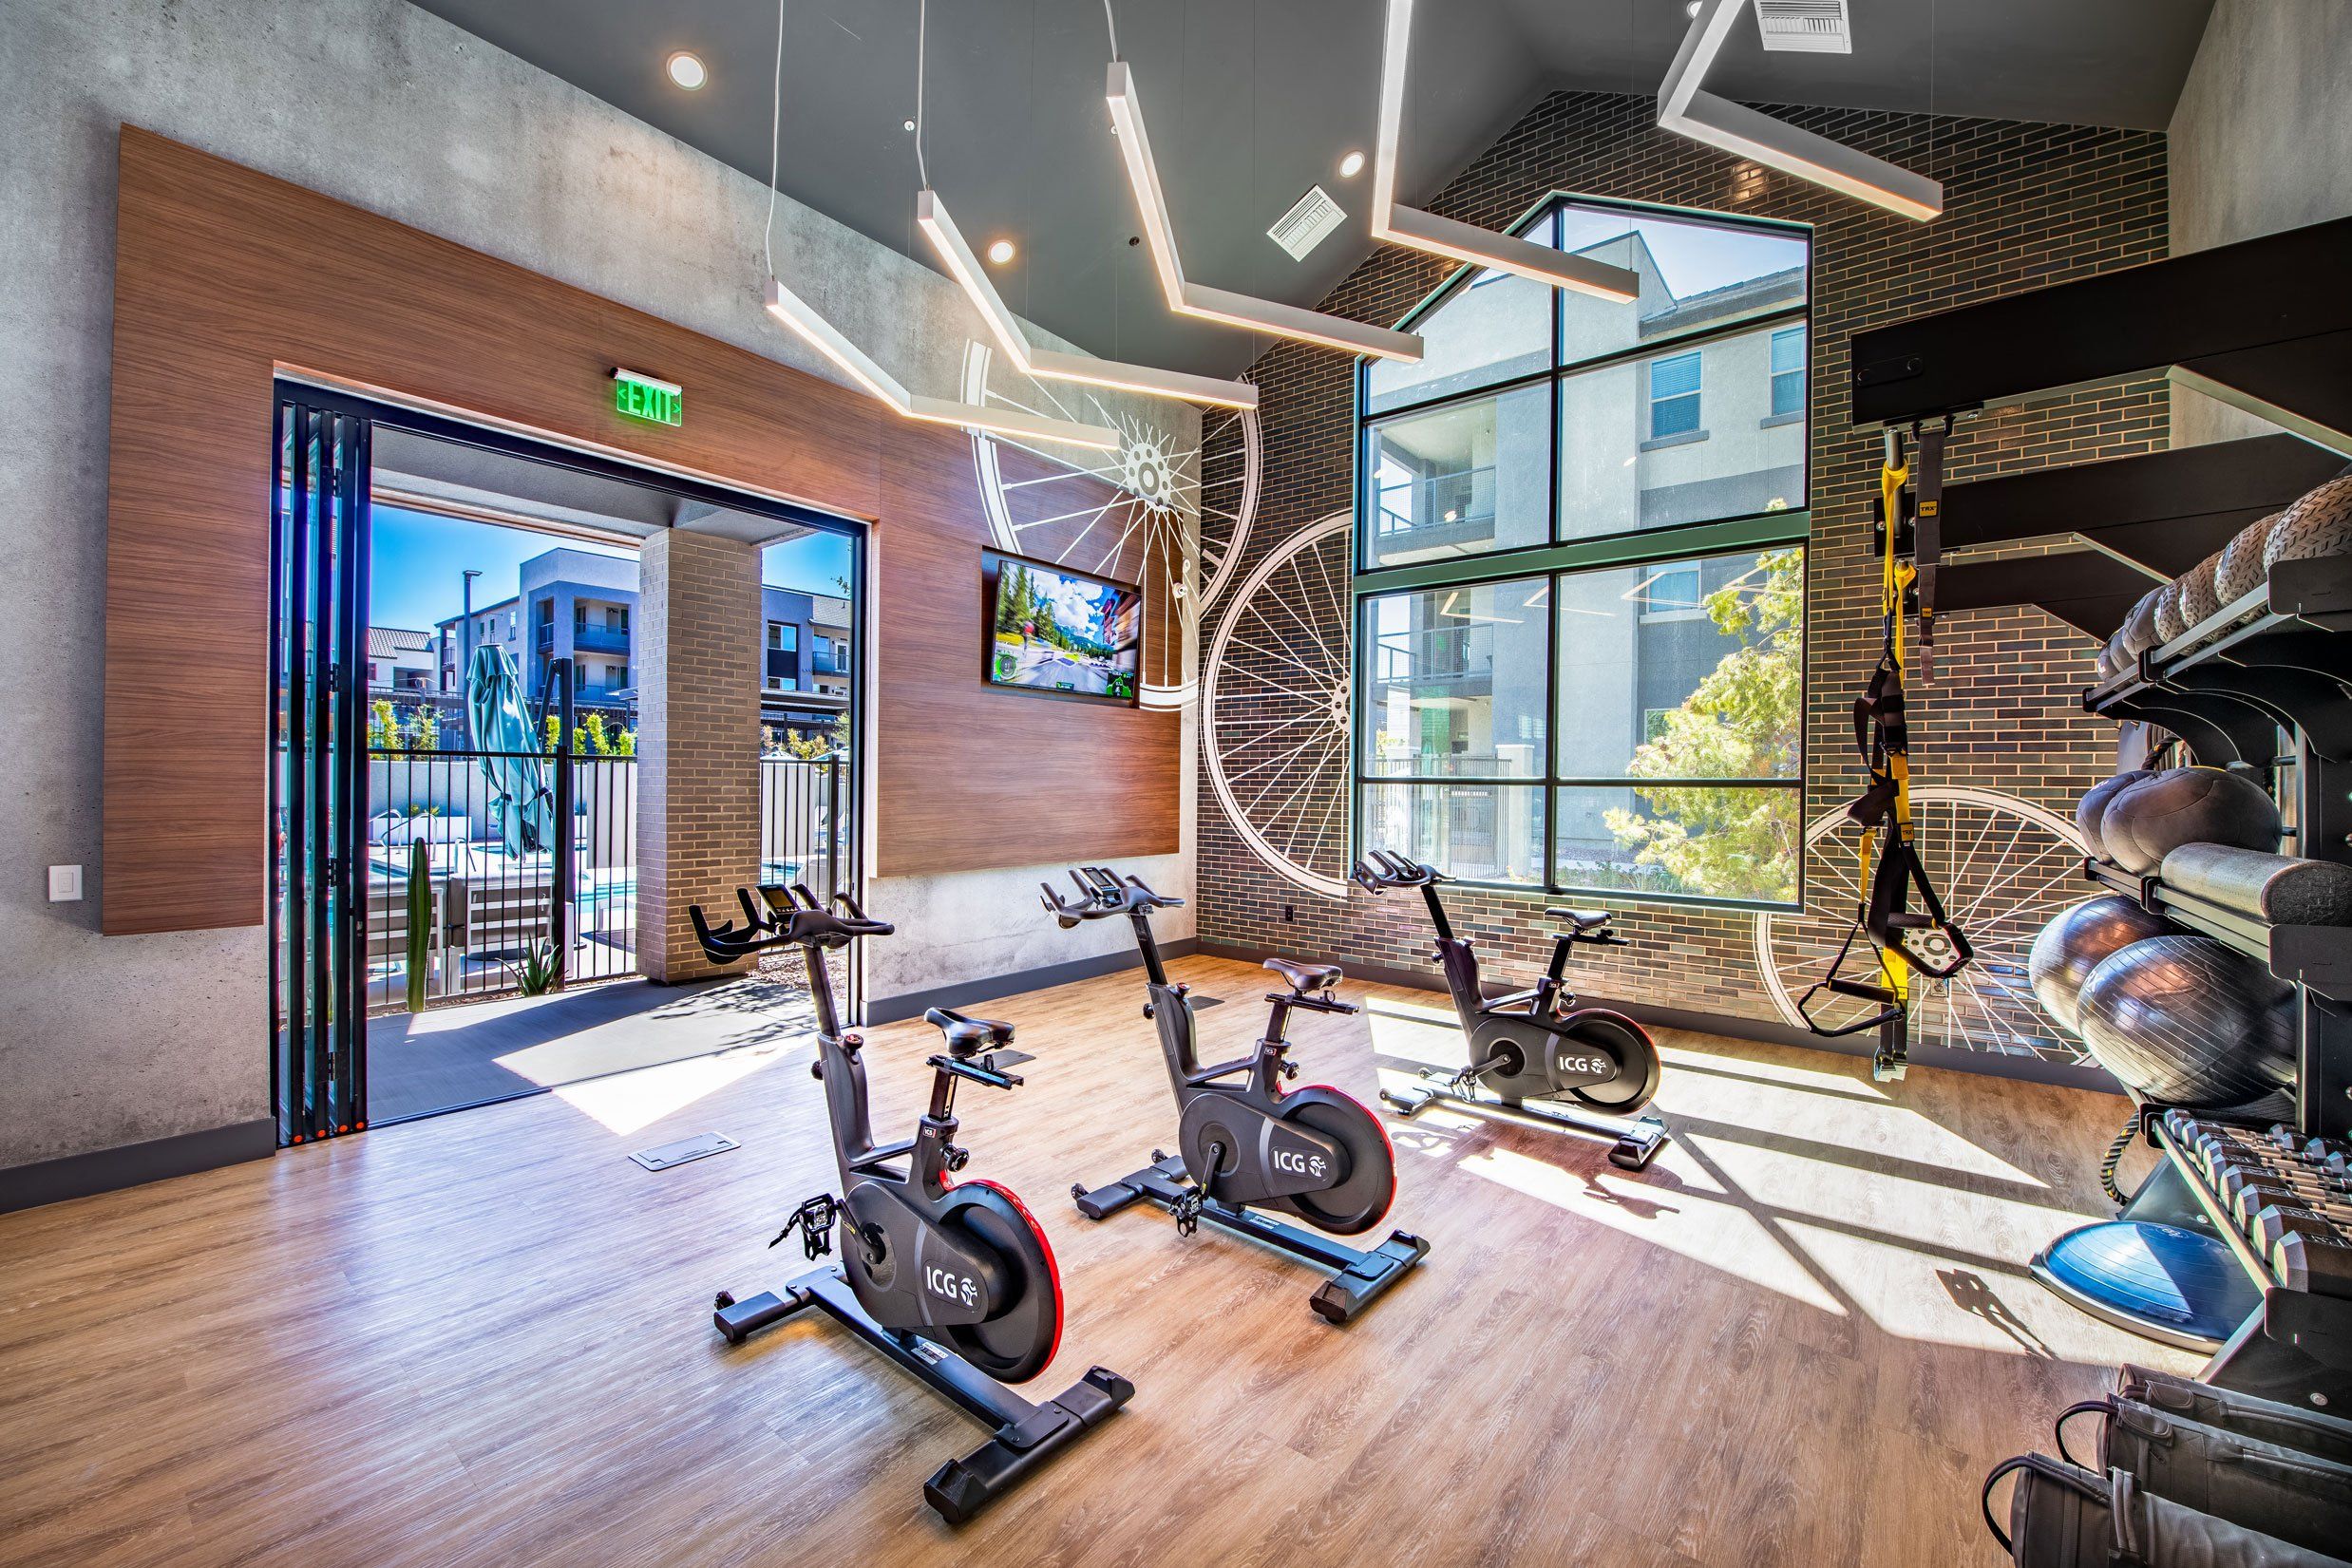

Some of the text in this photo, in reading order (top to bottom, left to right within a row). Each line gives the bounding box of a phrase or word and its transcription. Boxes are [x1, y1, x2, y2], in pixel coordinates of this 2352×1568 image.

[628, 379, 673, 424] EXIT
[1559, 1056, 1588, 1072] ICG
[1274, 1150, 1306, 1173] ICG
[926, 1265, 958, 1299] ICG
